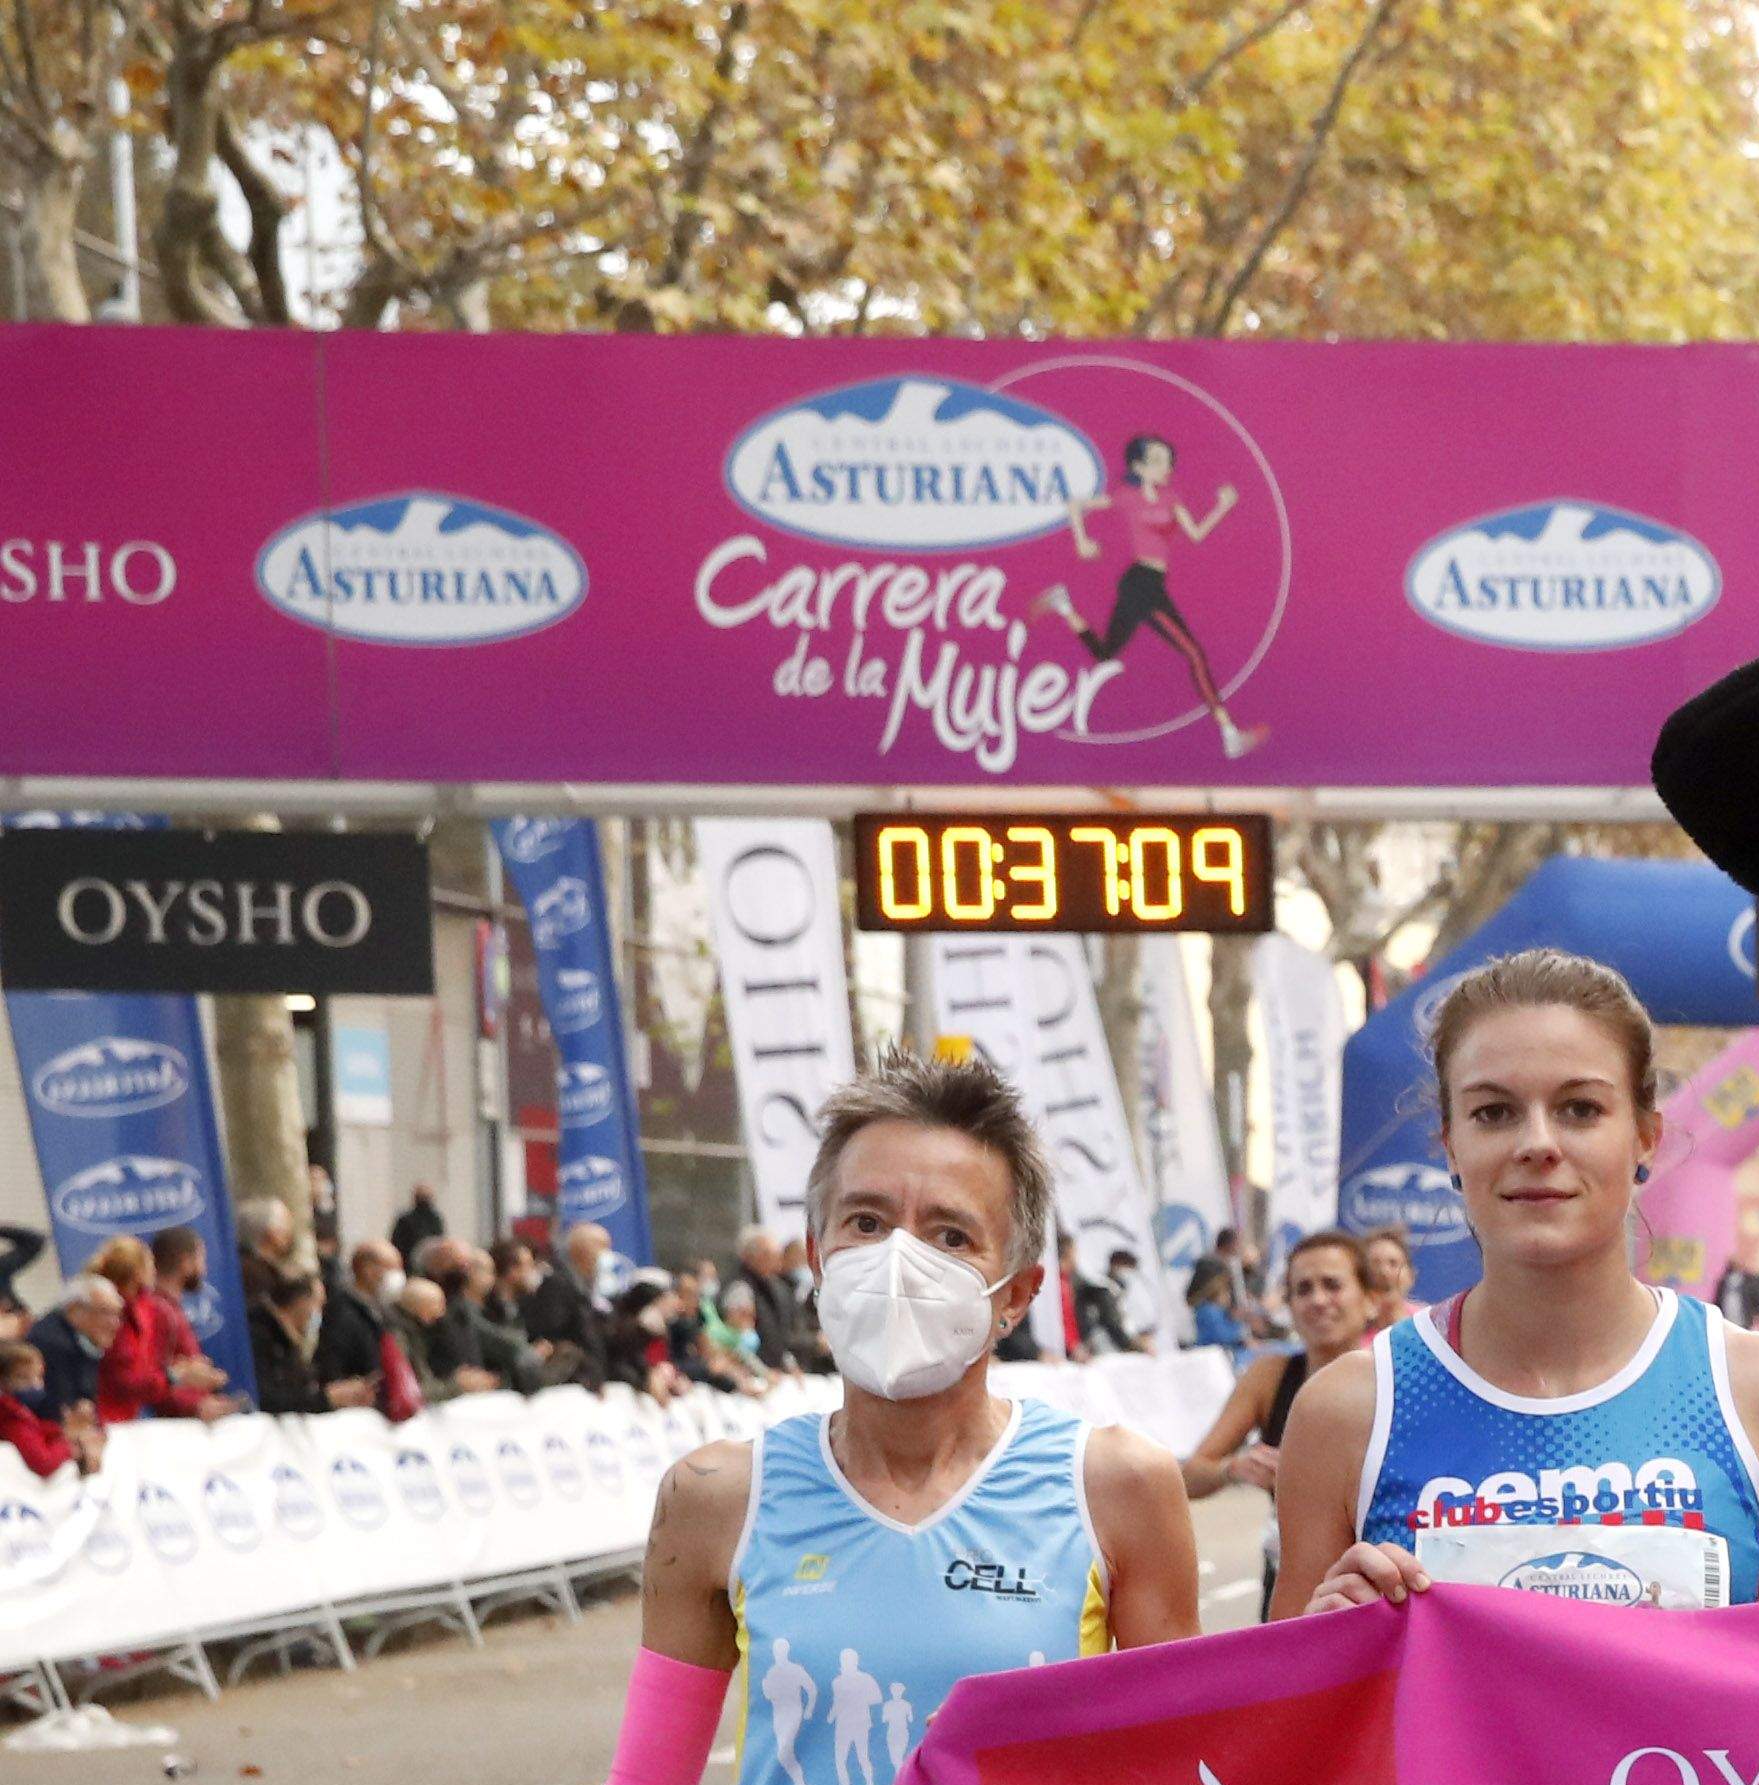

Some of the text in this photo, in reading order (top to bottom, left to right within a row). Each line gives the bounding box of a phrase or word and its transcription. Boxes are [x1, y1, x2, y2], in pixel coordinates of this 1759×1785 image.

[759, 440, 1070, 503] ASTURIANA
[286, 546, 558, 603] ASTURIANA
[694, 534, 1007, 629] Carrera
[1434, 556, 1692, 610] ASTURIANA
[773, 620, 1124, 773] de la Mujer
[878, 826, 1245, 920] 00:37:09
[57, 877, 373, 947] OYSHO
[944, 1559, 1036, 1595] CELL
